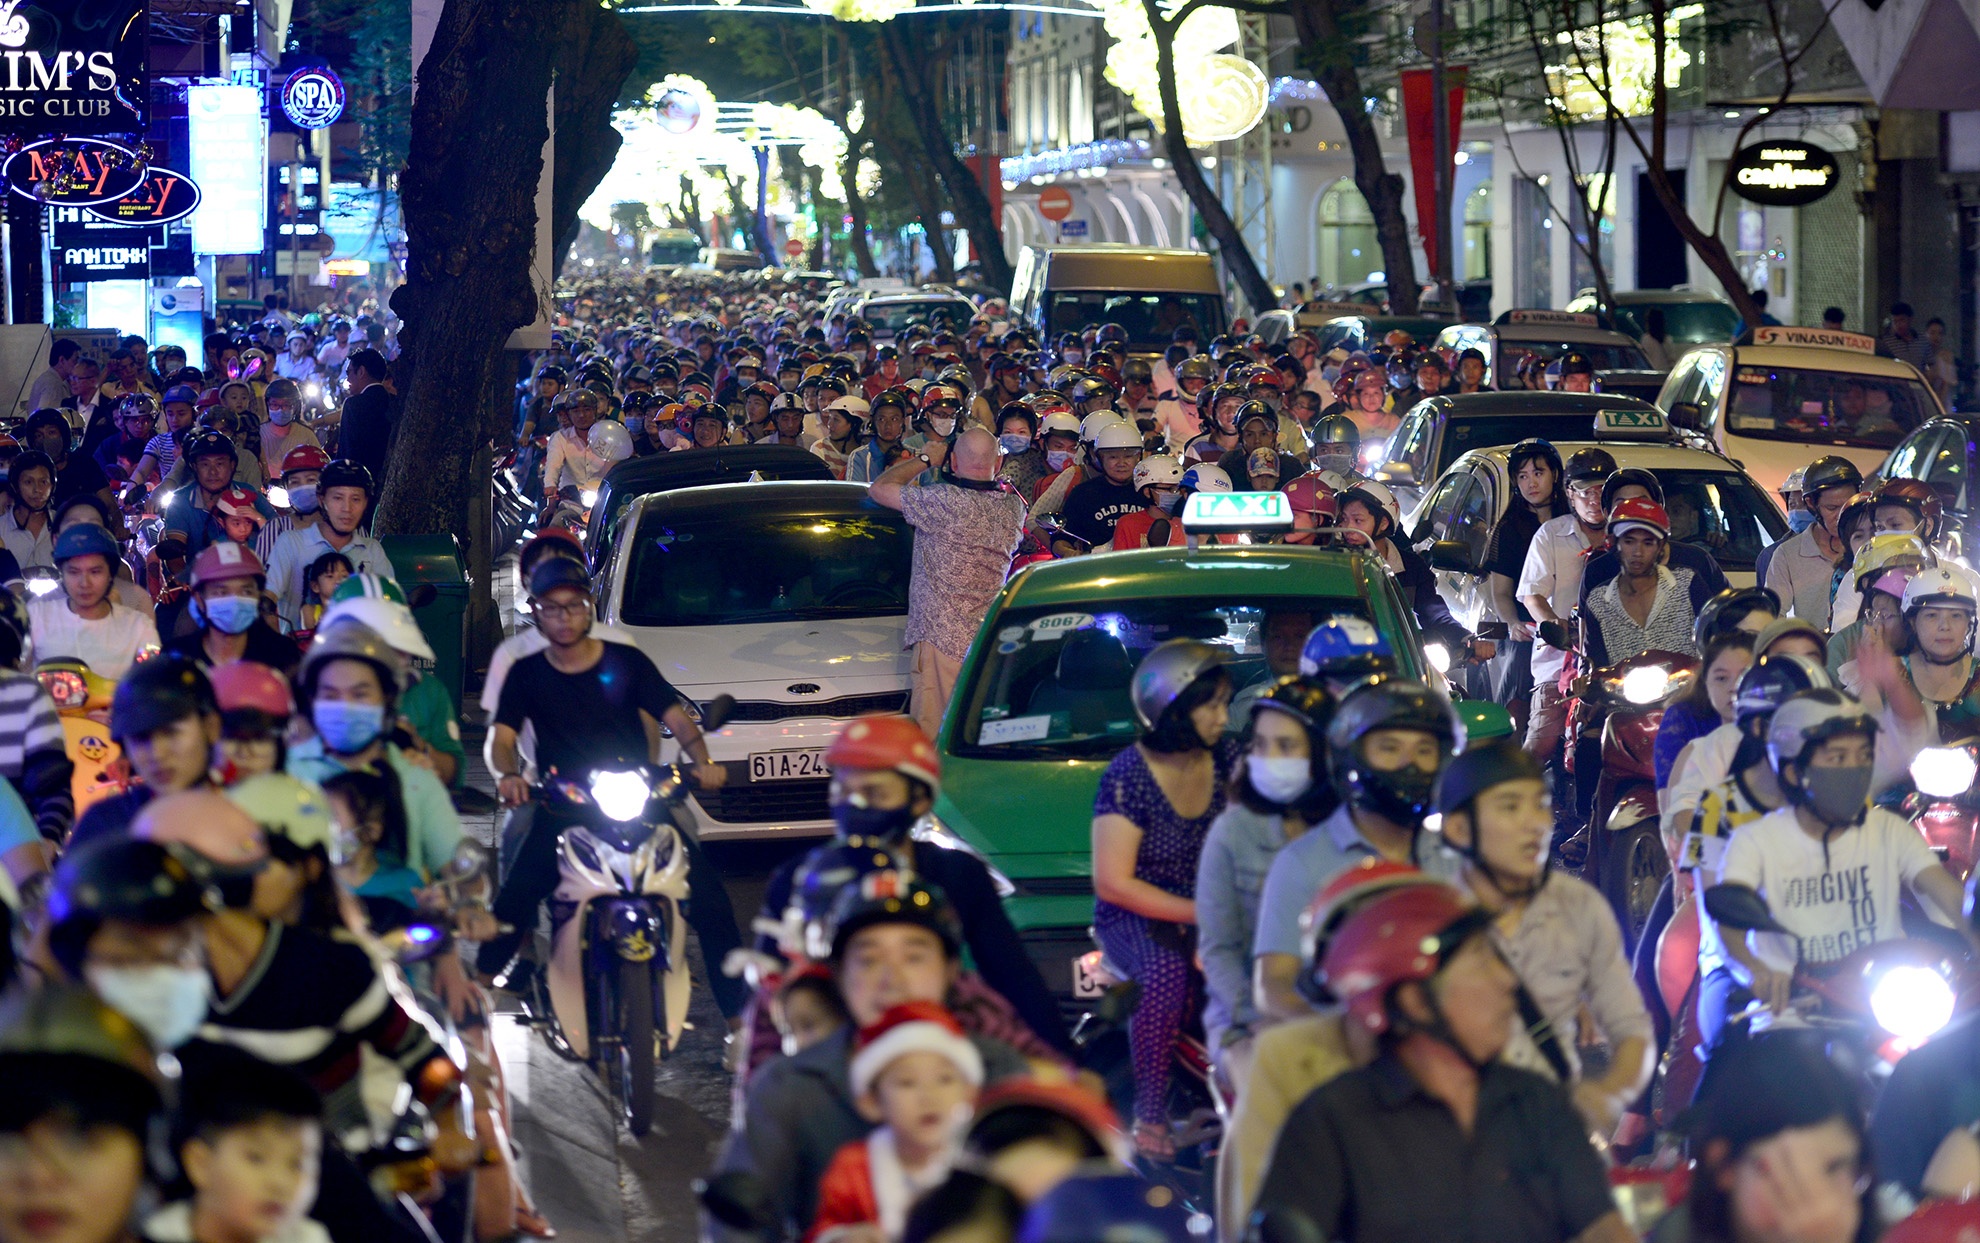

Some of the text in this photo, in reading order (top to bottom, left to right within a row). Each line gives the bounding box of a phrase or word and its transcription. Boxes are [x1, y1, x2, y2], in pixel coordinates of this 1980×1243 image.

[0, 50, 117, 91] IM'S
[43, 99, 111, 116] CLUB
[295, 82, 332, 109] SPA
[119, 177, 178, 216] AY
[1786, 332, 1872, 350] VINASUN TAXI
[1094, 503, 1146, 521] OLD NAV
[1039, 615, 1087, 629] 8067
[753, 753, 832, 778] 61A-24
[1848, 895, 1877, 928] TO
